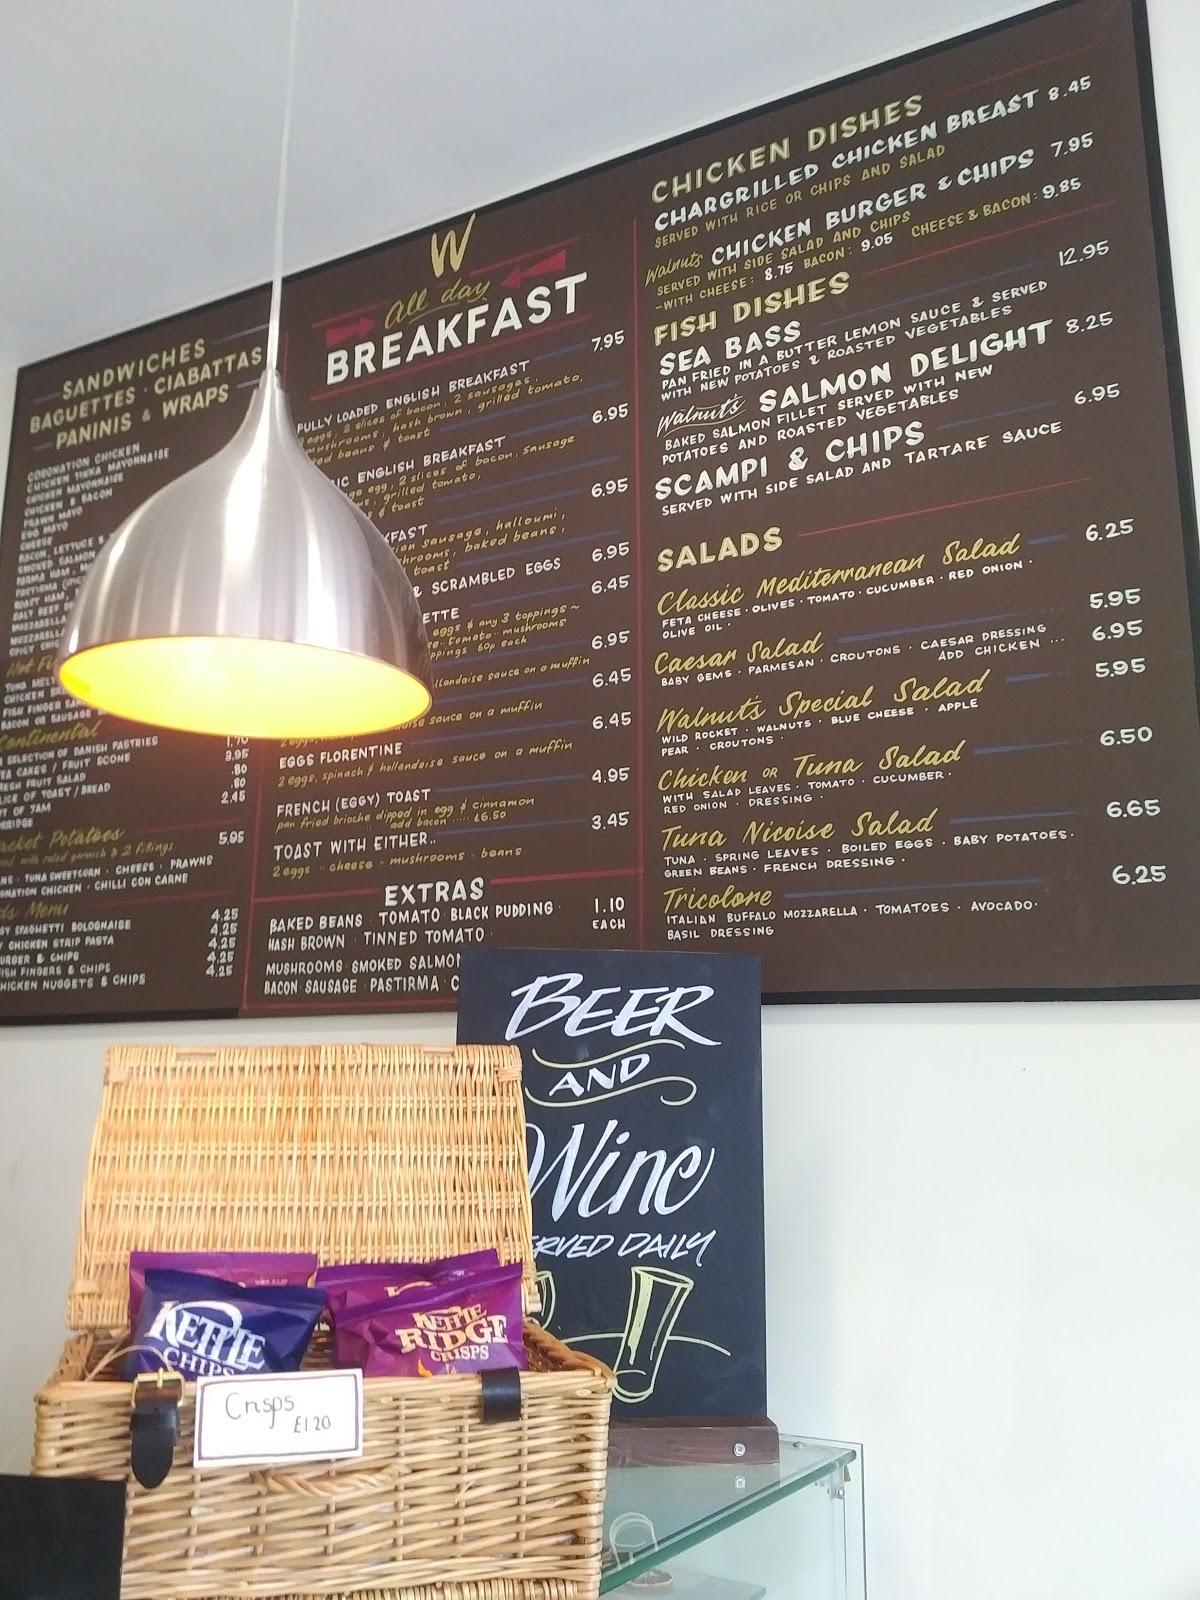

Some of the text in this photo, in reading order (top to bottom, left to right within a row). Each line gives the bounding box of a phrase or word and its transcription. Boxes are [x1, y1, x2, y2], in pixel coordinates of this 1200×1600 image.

[651, 94, 922, 203] CHICKEN DISHES
[654, 74, 1091, 231] CHARGRILLED CHICKEN BREAST 8.45
[644, 131, 1093, 288] Walnuts CHICKEN BURGER & CHIPS 7.95
[654, 144, 945, 249] SERVED WITH RICE OR CHIPS AND SALAD
[764, 260, 793, 281] 8.75
[860, 231, 893, 252] 9.05
[911, 212, 964, 237] CHEESE
[967, 208, 979, 221] &
[1041, 177, 1081, 199] 9.85
[326, 271, 587, 385] BREAKFAST
[653, 271, 850, 346] FISH DISHES
[659, 239, 1109, 376] SEA BASS 12.95
[661, 280, 1047, 390] PAN FRIED IN A BUTTER LEMON SAUCE & SERVED
[29, 346, 262, 434] BAGUETTES CIABATTAS
[62, 337, 205, 400] SANDWICHES
[336, 402, 378, 424] LOADED
[385, 384, 440, 409] ENGLISH
[448, 359, 530, 393] BREAKFAST
[591, 329, 625, 352] 7.95
[758, 361, 891, 413] SALMON
[909, 318, 1053, 377] DELIGHT
[1065, 310, 1113, 334] 8.25
[55, 383, 229, 450] PANINIS & WRAPS
[357, 402, 628, 484] ENGLISH BREAKFAST 6.95
[654, 382, 1120, 500] SCAMPI & CHIPS 6.95
[661, 420, 1062, 516] SERVED WITH SIDE SALAD AND TARTARE SAUCE
[431, 541, 630, 595] SCRAMBLED EGGS 6.95
[656, 518, 1134, 616] Classic Mediterranean Salad 6.25
[657, 526, 783, 572] SALADS
[662, 559, 1023, 628] FETA CHEESE OLIVES TOMATO CUCUMBER RED ONION
[654, 587, 1141, 675] Caesar Salad 5.95
[938, 619, 1143, 661] ADD CHICKEN 6.95
[778, 684, 874, 719] Special
[893, 668, 991, 703] Salad
[1095, 657, 1146, 678] 5.95
[278, 711, 631, 769] EGGS FLORENTINE 6.45
[657, 725, 1153, 791] Chicken OR Tuna Salad 6.50
[276, 766, 630, 817] FRENCH (EGGY) TOAST 4.95
[661, 798, 1161, 852] Tuna Nicoise Salad 6.65
[273, 840, 322, 861] TOAST
[330, 837, 366, 854] WITH
[591, 811, 630, 830] 3.45
[210, 907, 239, 922] 4.25
[269, 896, 624, 935] BAKED BEANS TOMATO BLACK PUDDING 1.10
[384, 876, 484, 906] EXTRAS
[663, 864, 1167, 914] Tricolore 6.25
[267, 926, 485, 951] HASH BROWN TINNED TOMATO
[504, 972, 722, 1046] BEER
[549, 1053, 651, 1098] AND
[525, 1119, 715, 1222] Wine
[617, 1229, 717, 1268] DAILY
[144, 1300, 266, 1372] KETTLE
[394, 1314, 509, 1354] RIDGE
[412, 1303, 488, 1333] KETTLE
[430, 1344, 490, 1363] CRISPS
[225, 1392, 295, 1430] Crisps
